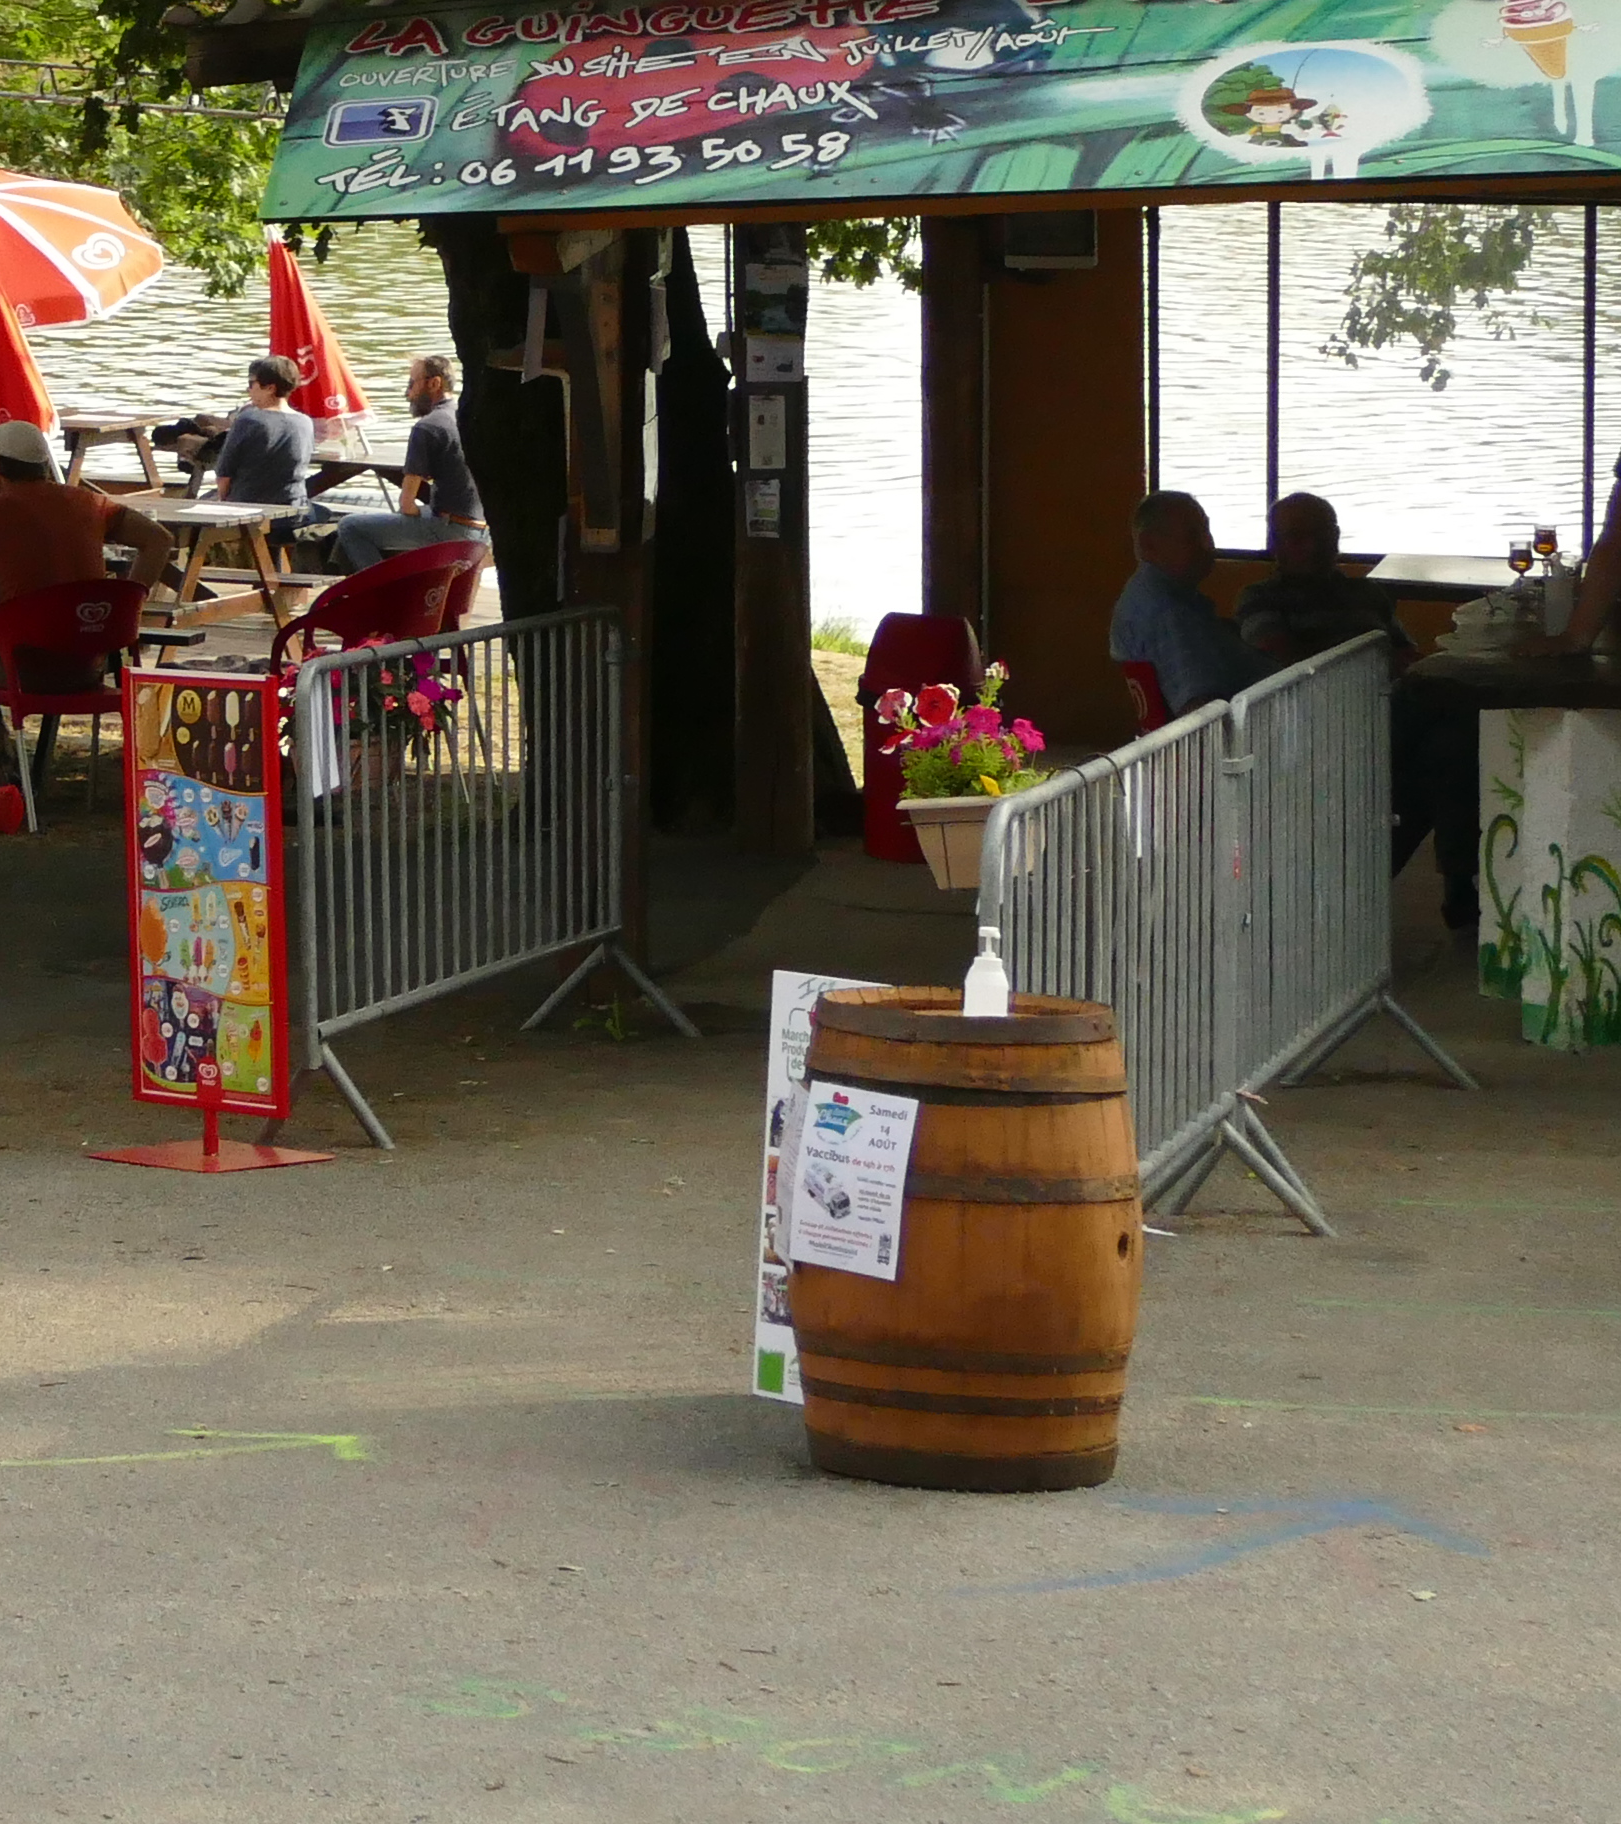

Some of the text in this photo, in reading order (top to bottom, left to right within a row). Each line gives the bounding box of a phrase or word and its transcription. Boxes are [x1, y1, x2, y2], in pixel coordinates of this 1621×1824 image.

[345, 16, 449, 57] LA
[339, 58, 518, 88] OUVERTURE
[524, 57, 574, 83] DU
[717, 34, 828, 68] EN
[450, 91, 608, 134] ÉTANG
[624, 87, 703, 129] DE
[707, 80, 879, 120] CHAUX
[460, 159, 518, 187] 06
[534, 150, 593, 178] 11
[606, 145, 683, 187] 93
[701, 139, 763, 171] 50
[766, 131, 851, 172] 58
[869, 1104, 908, 1122] Samedi
[806, 1146, 851, 1164] Vaccibus
[868, 1137, 898, 1151] AOÛT
